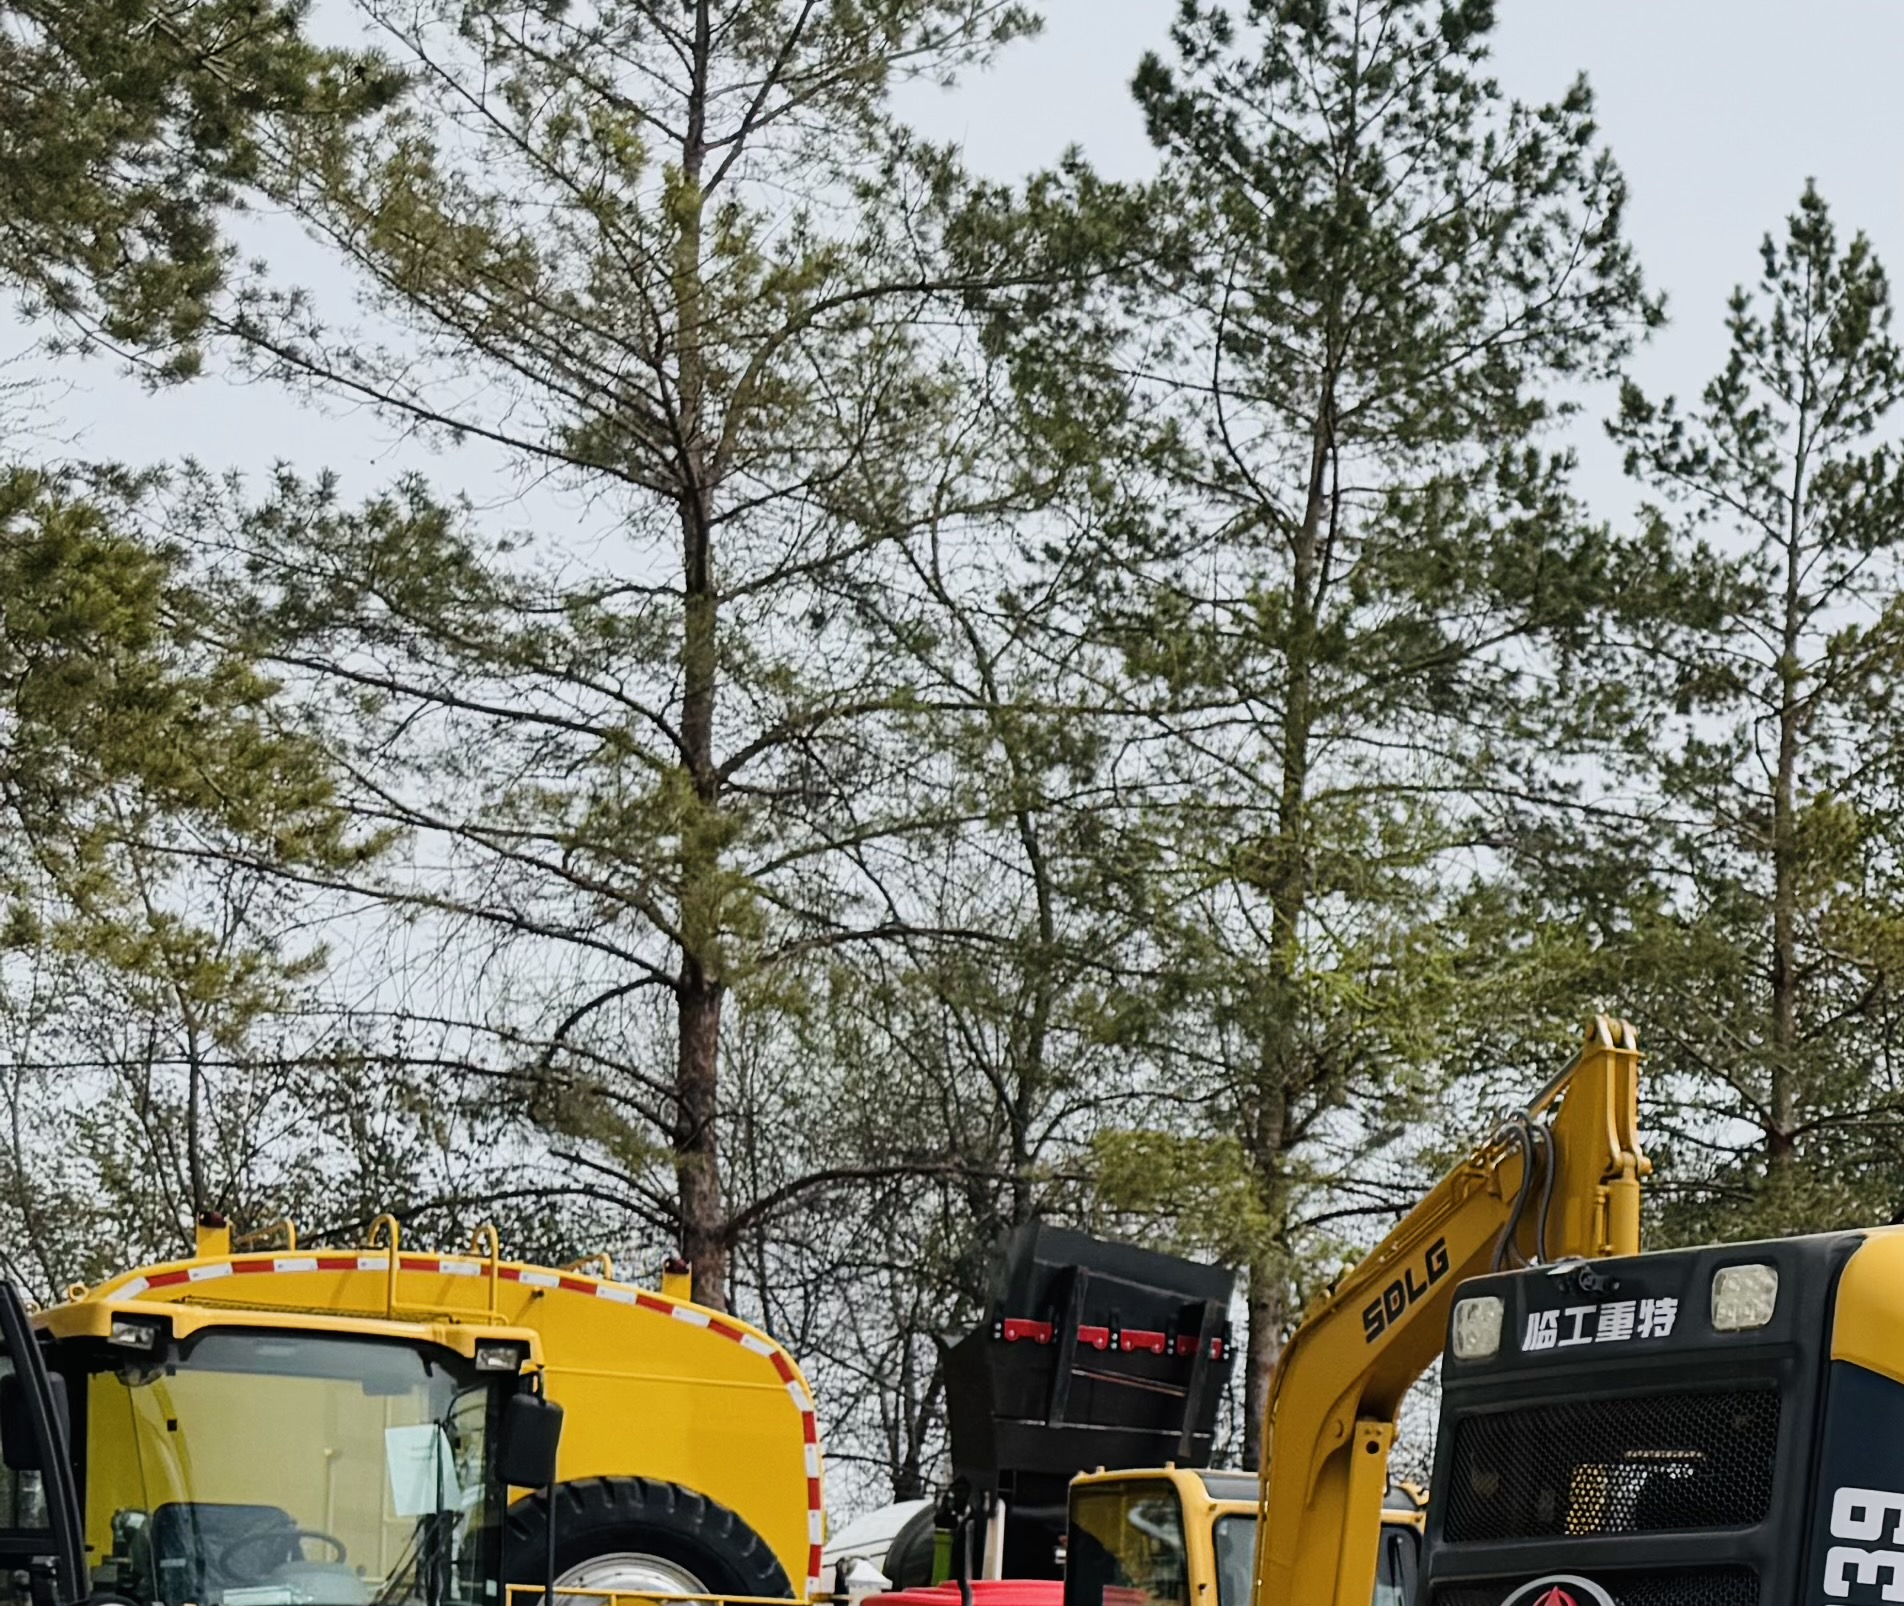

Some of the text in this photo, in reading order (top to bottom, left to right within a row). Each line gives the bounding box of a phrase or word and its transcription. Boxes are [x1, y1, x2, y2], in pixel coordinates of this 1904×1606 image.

[1362, 1237, 1450, 1344] SDLG
[1522, 1298, 1678, 1351] 临工重特
